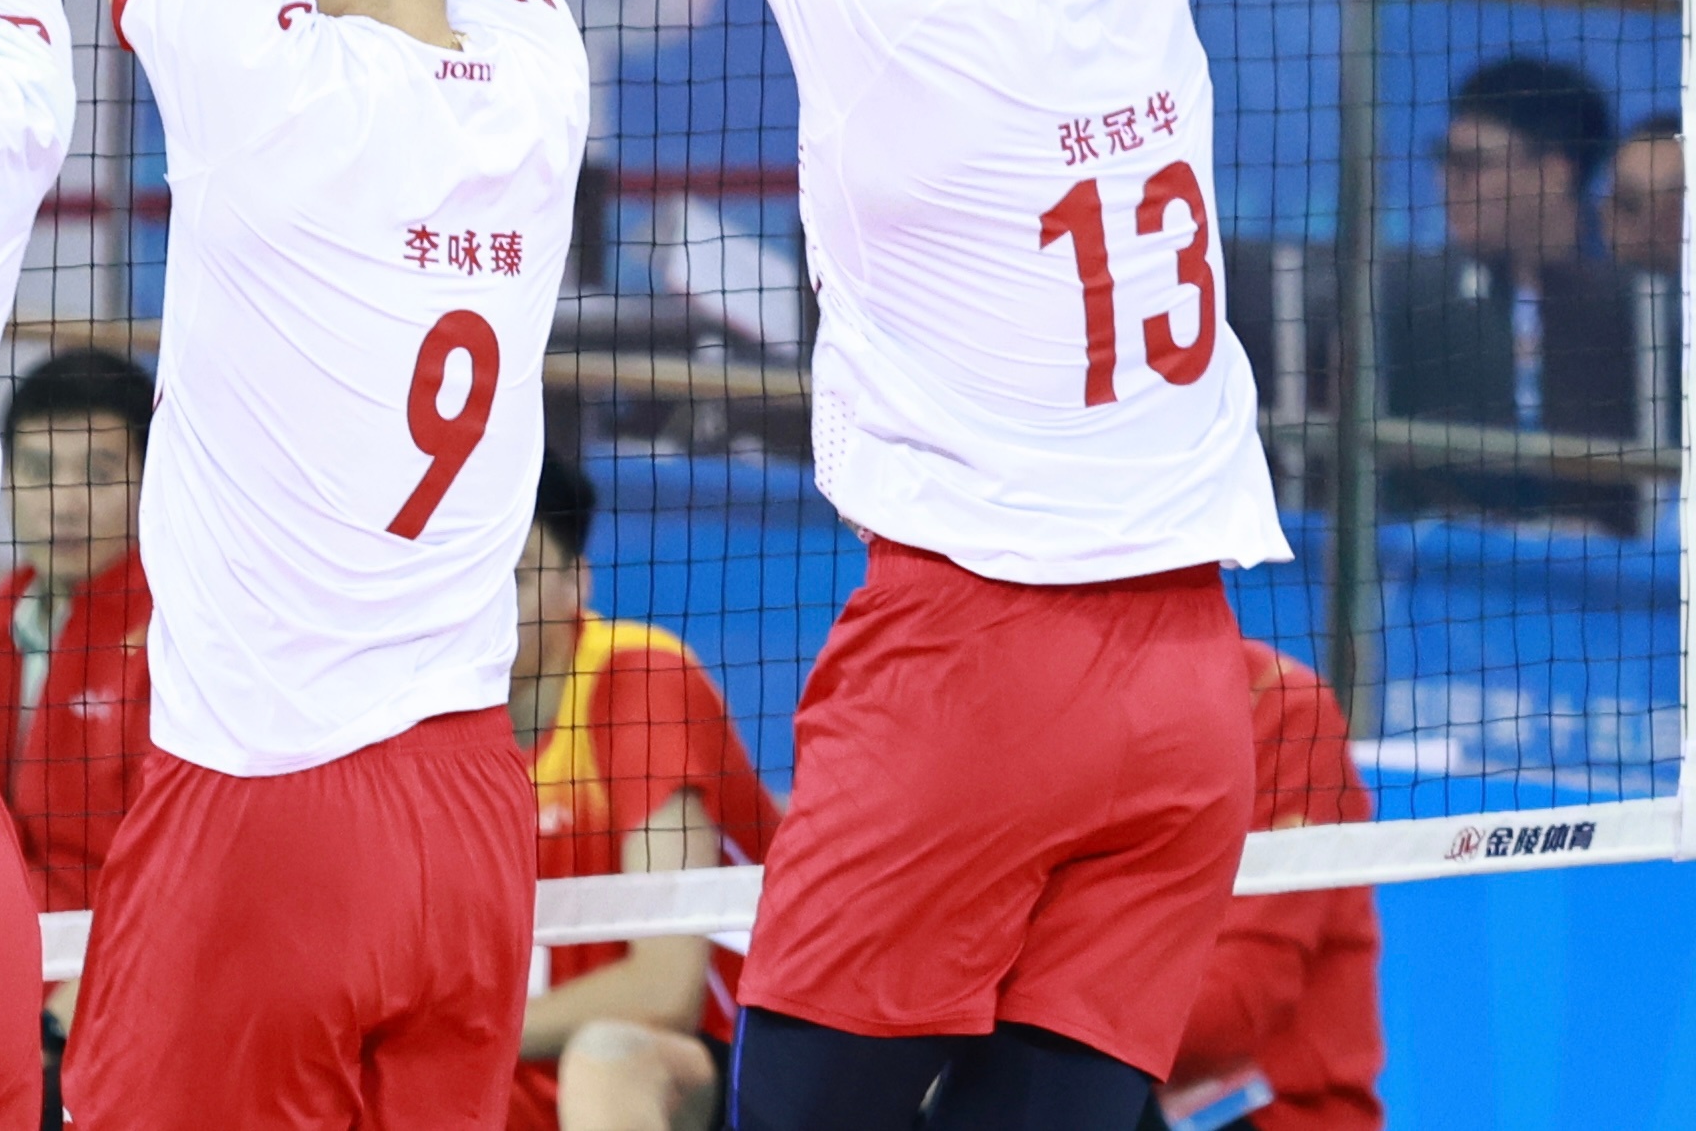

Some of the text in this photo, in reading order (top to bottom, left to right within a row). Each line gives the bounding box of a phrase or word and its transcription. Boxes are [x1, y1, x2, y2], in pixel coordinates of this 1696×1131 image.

[435, 59, 496, 82] Jom
[1058, 90, 1180, 167] 张冠华
[403, 224, 523, 277] 李咏臻
[1039, 160, 1217, 408] 13
[385, 309, 500, 541] 9
[1485, 822, 1596, 858] 金陵体育
